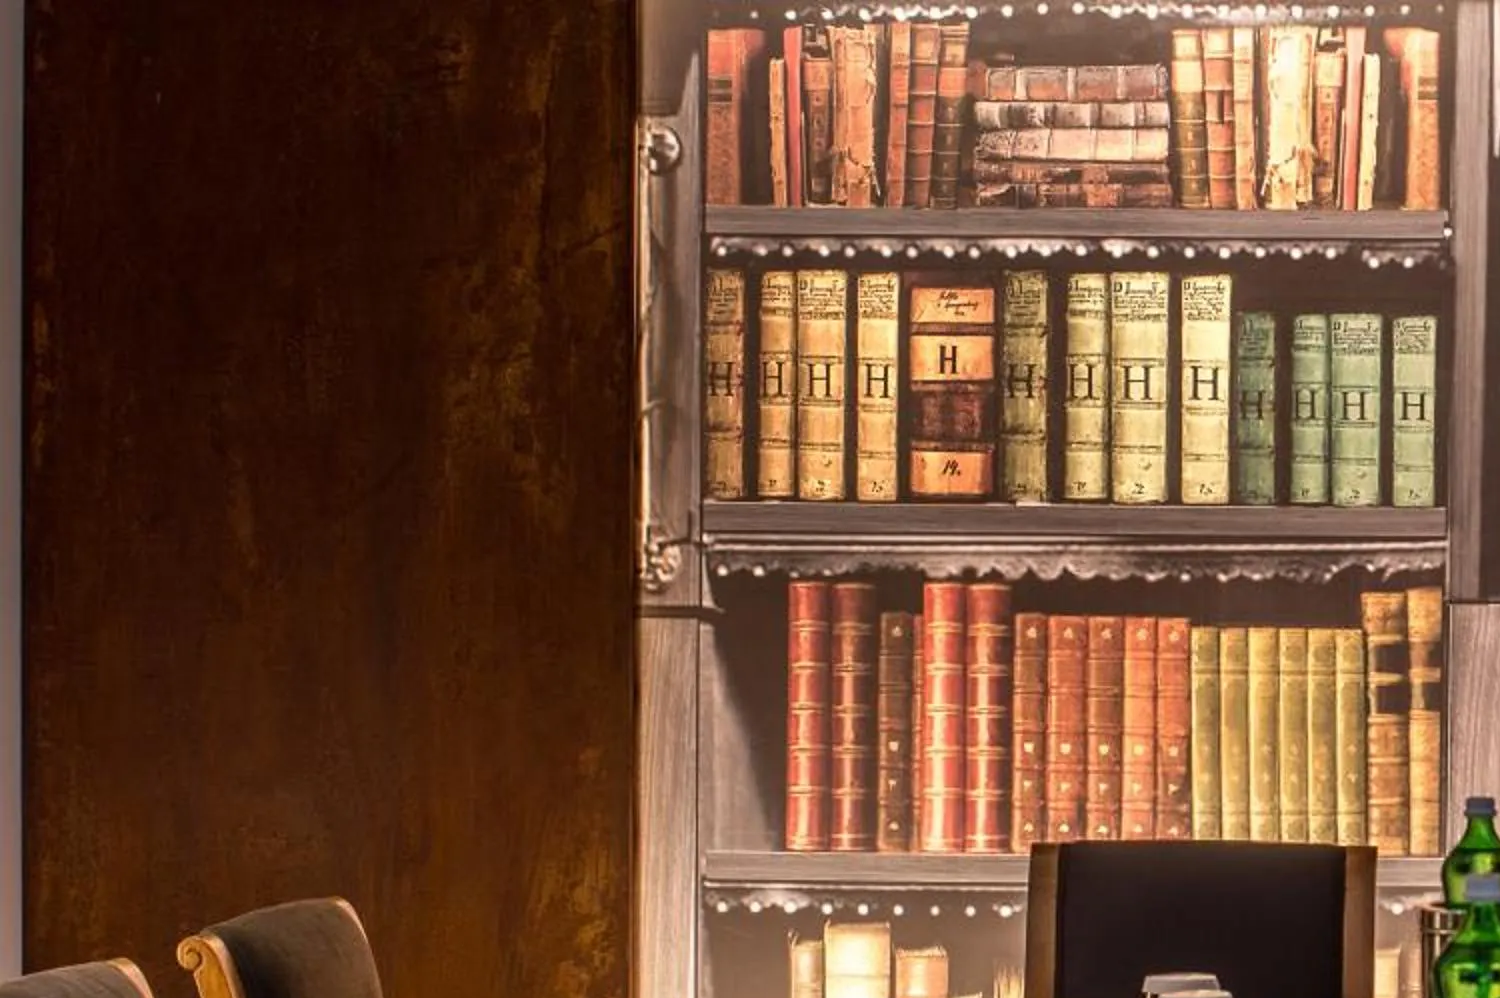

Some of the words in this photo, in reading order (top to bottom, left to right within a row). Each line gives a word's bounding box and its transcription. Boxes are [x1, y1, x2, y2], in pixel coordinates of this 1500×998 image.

[939, 345, 957, 374] H
[709, 361, 733, 397] H
[762, 361, 784, 397] H
[808, 363, 832, 398] H
[865, 363, 890, 398] H
[1008, 364, 1035, 398] H
[1069, 363, 1099, 400] H
[1123, 365, 1153, 401] H
[1191, 365, 1221, 401] H
[1240, 390, 1265, 420] H
[1294, 390, 1318, 420] H
[1342, 391, 1367, 421] H
[1401, 391, 1426, 421] H
